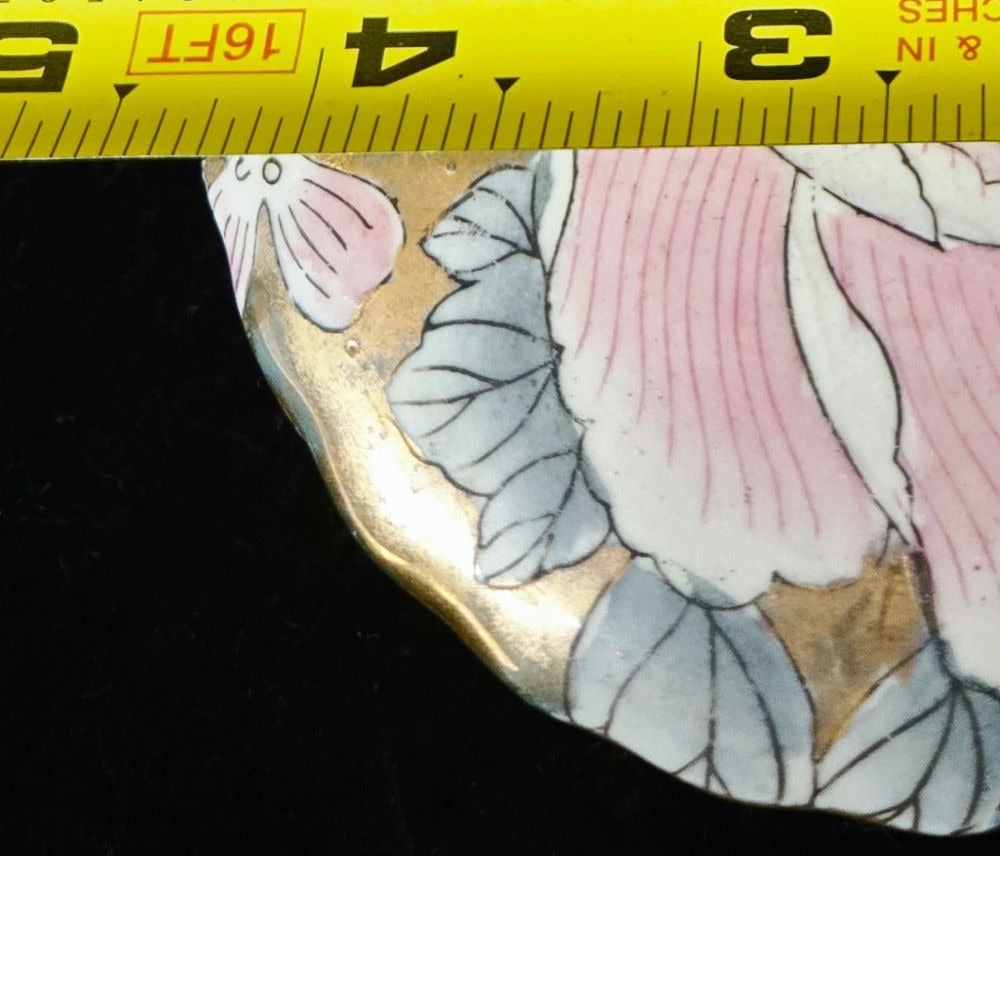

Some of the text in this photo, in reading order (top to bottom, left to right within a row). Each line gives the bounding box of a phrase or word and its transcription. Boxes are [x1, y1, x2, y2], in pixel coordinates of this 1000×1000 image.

[0, 21, 78, 93] 5
[147, 23, 279, 63] 16FT
[345, 17, 458, 88] 4
[724, 9, 832, 81] 3
[898, 37, 935, 61] IN
[958, 36, 981, 60] &
